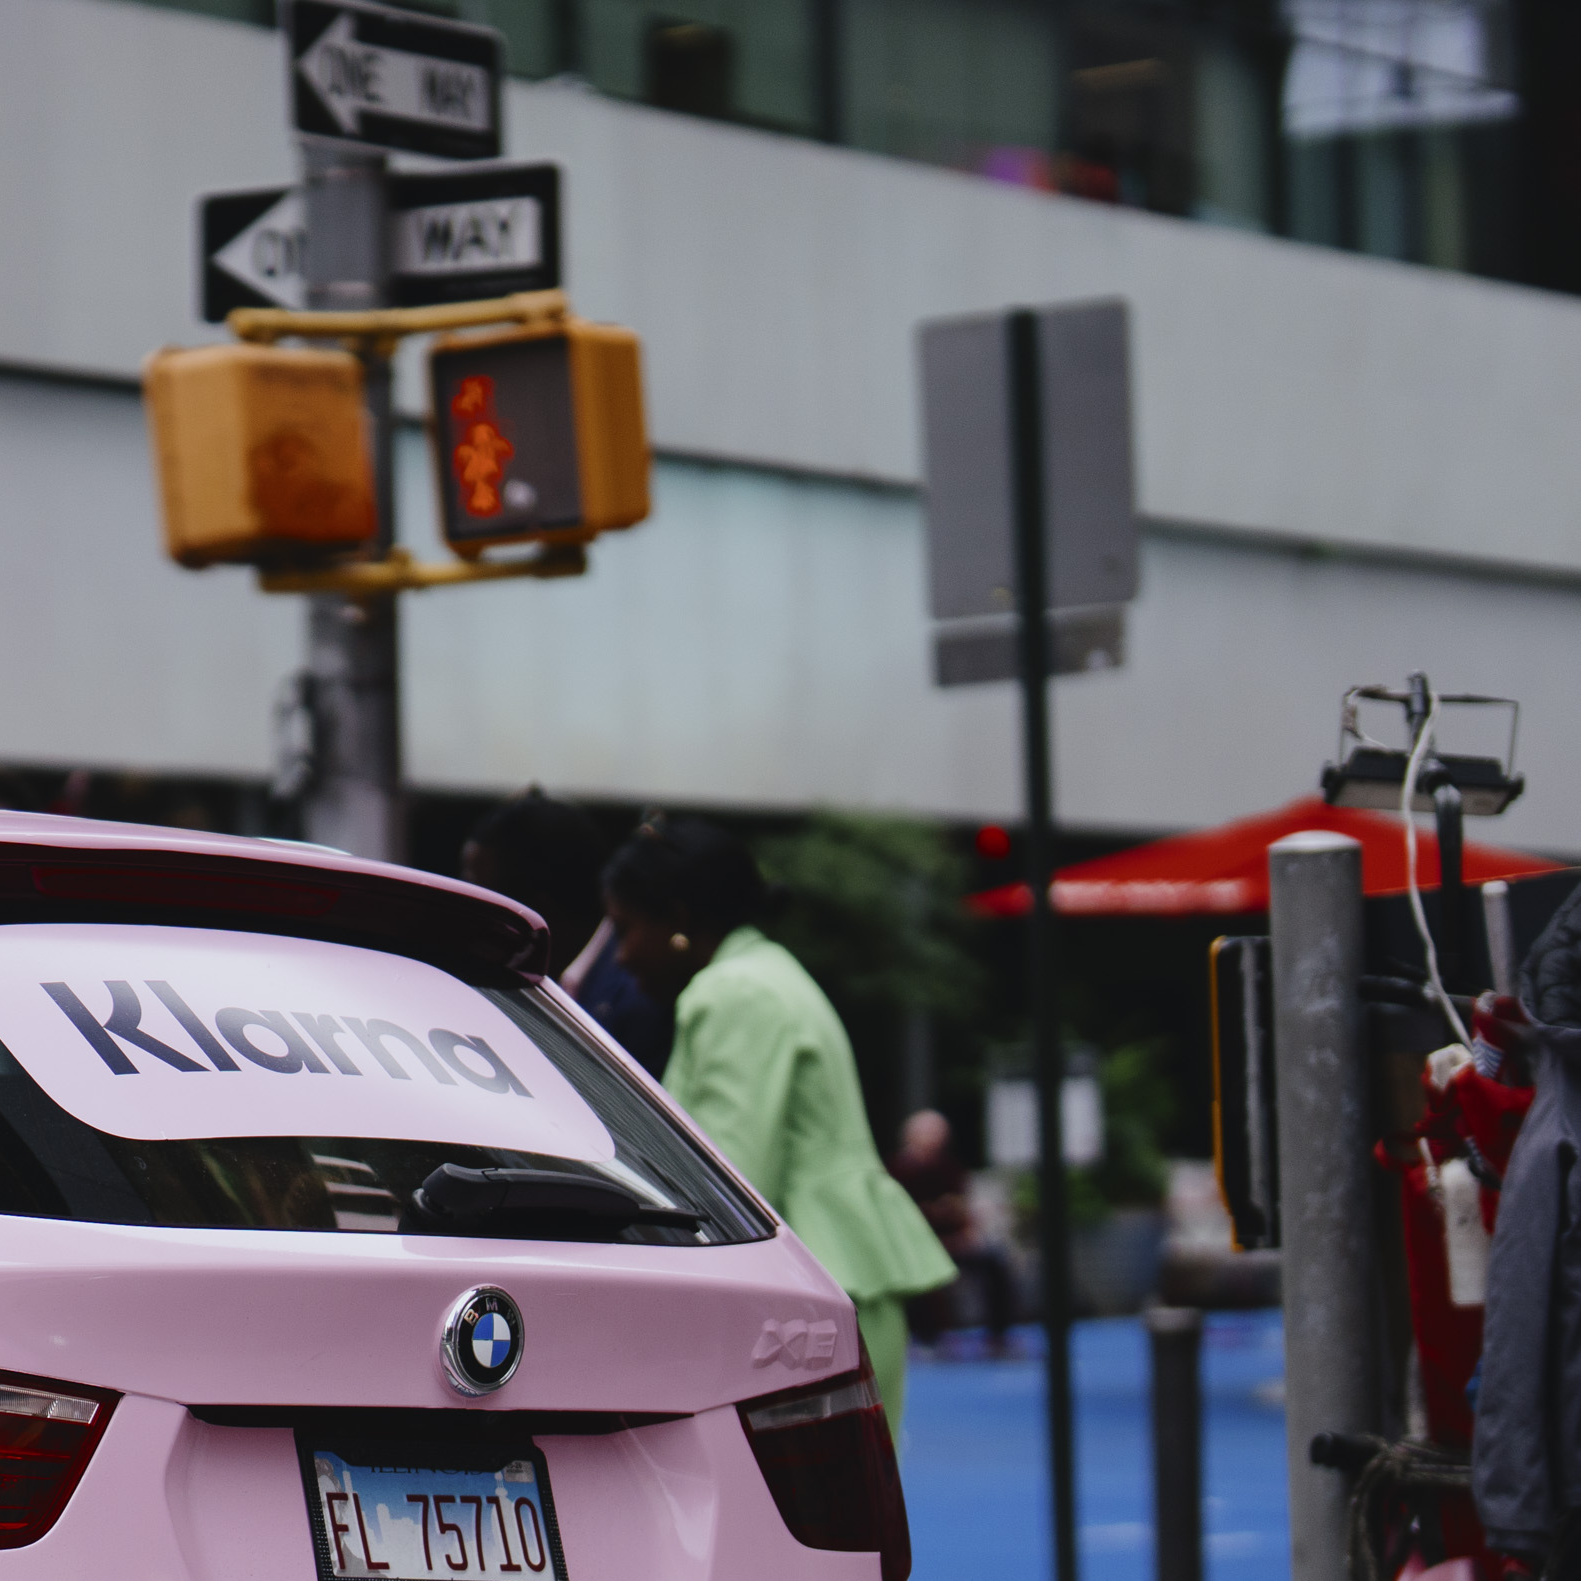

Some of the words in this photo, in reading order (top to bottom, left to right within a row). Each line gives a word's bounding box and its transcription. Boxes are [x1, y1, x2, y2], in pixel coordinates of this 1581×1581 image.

[320, 42, 384, 104] ONE
[418, 66, 477, 120] WAY
[249, 225, 304, 278] ON
[412, 203, 522, 264] WAY
[40, 980, 535, 1098] Klarna
[463, 1296, 516, 1327] BMW
[326, 1491, 391, 1571] FL
[405, 1493, 547, 1573] 75710
